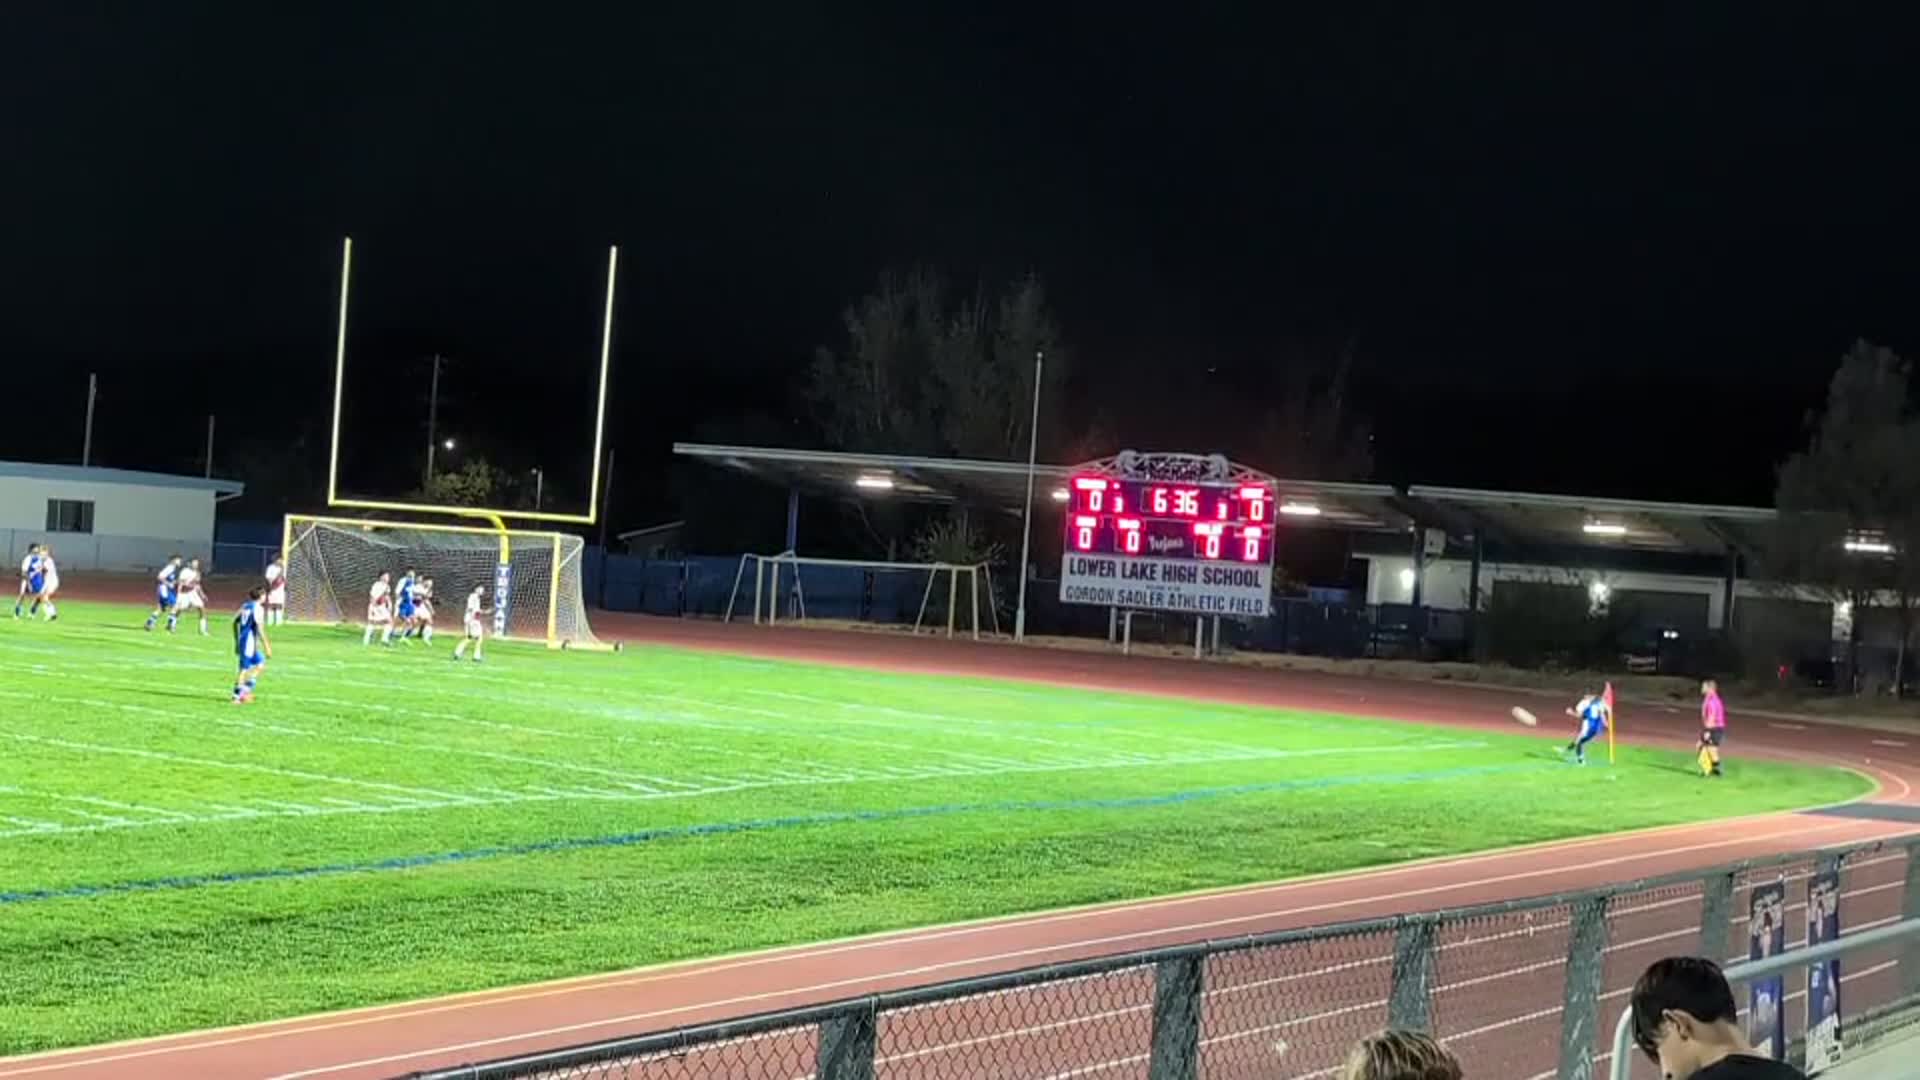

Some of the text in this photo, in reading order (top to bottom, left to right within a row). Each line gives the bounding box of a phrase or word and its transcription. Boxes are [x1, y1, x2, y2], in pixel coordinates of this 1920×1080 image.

[1090, 490, 1102, 512] 0
[1251, 500, 1264, 521] 0
[1079, 528, 1091, 549] 0
[1128, 531, 1140, 552] 0
[1206, 536, 1219, 558] 0
[1245, 539, 1258, 560] 0
[1069, 558, 1262, 590] LOWER LAKE HIGH SCHOOL
[1066, 585, 1114, 602] GORDON
[1117, 588, 1164, 606] SADLER
[1170, 593, 1225, 612] ATHLETIC
[1229, 597, 1263, 614] FIELD
